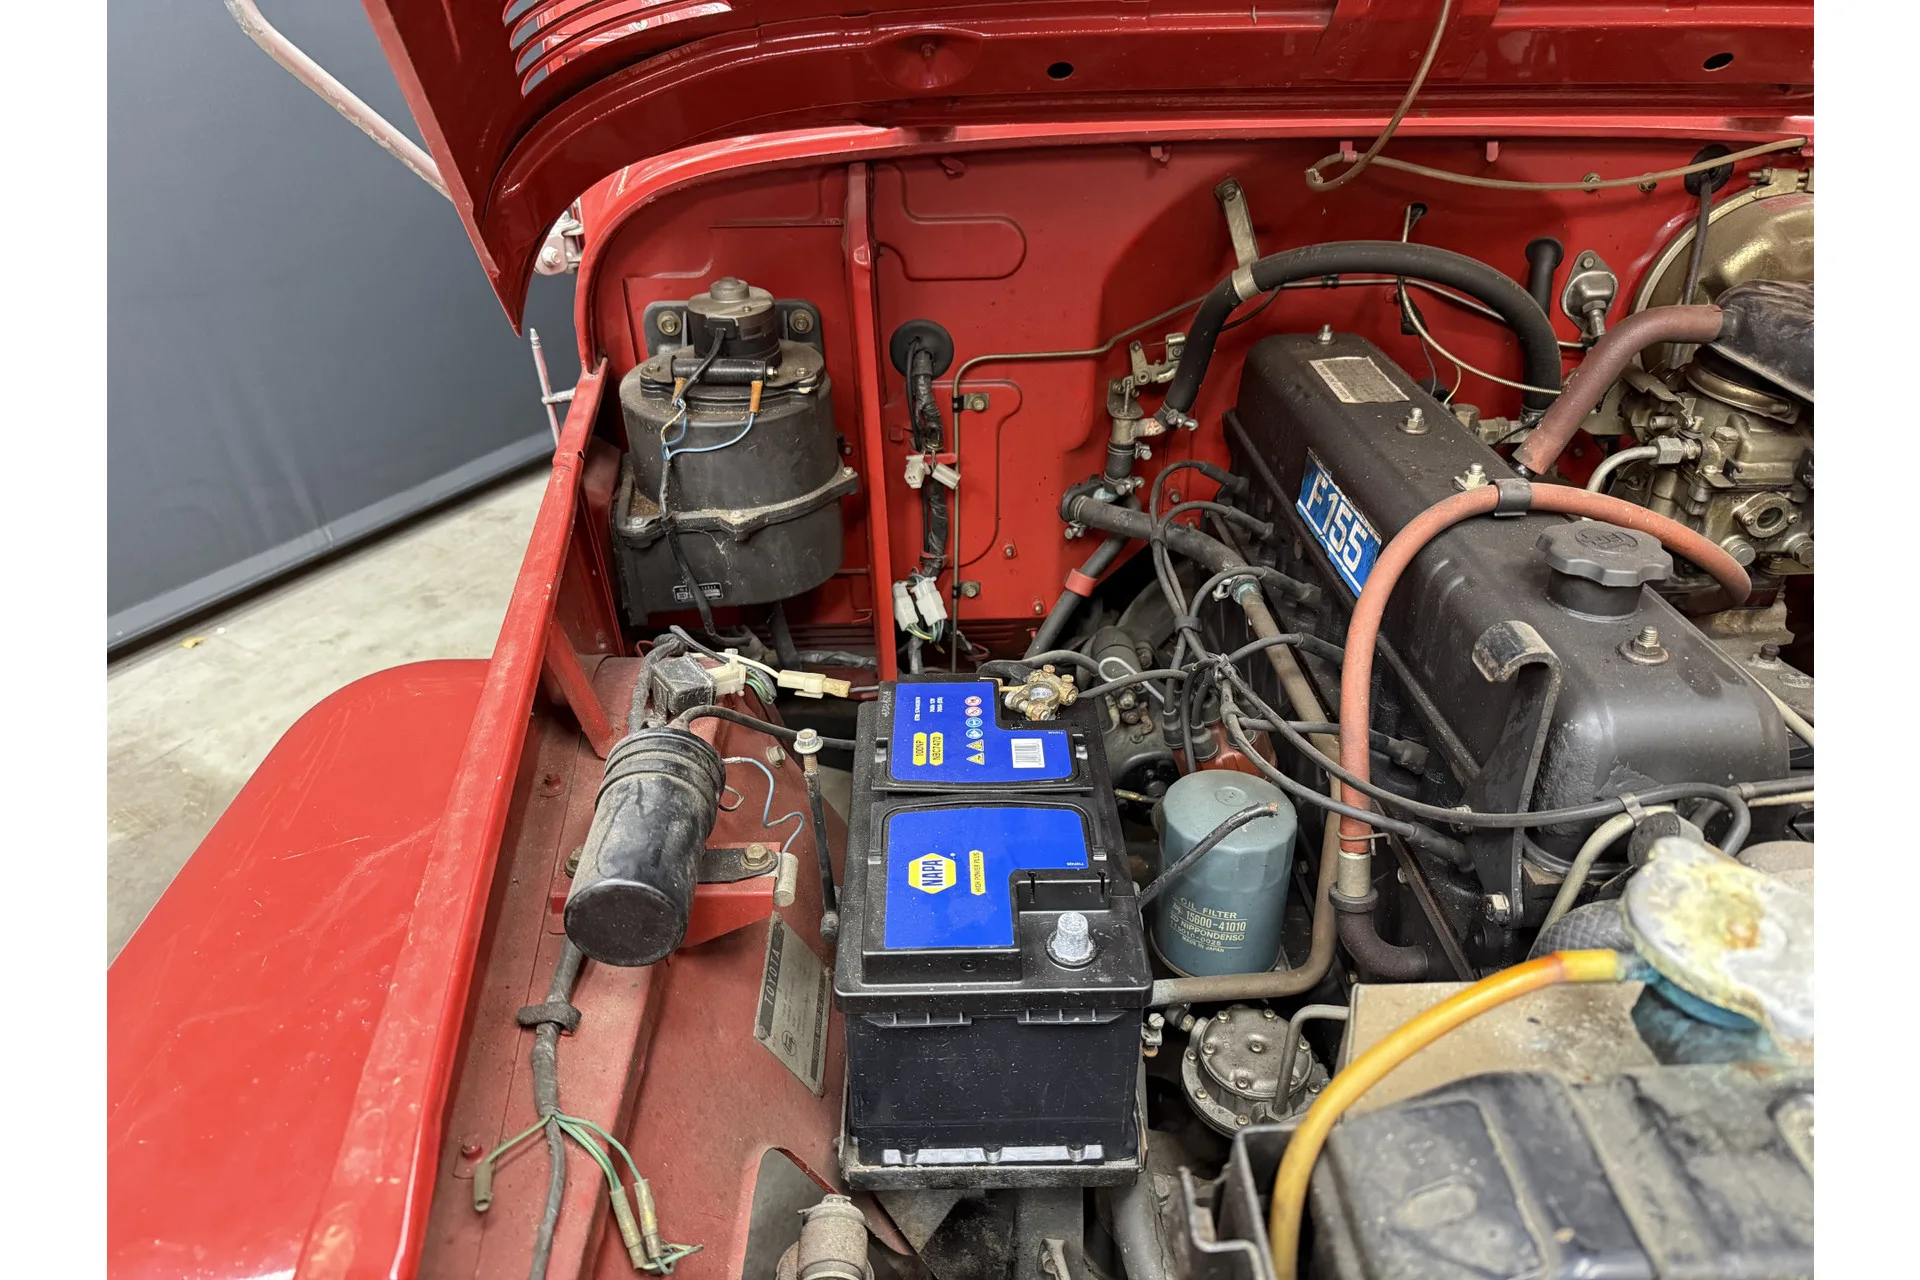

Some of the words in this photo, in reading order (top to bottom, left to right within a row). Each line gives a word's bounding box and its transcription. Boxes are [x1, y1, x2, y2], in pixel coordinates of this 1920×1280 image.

[1306, 472, 1368, 573] F155
[915, 740, 924, 757] 100NP
[932, 736, 942, 761] NBC7470
[921, 859, 944, 887] NAPA
[1181, 897, 1197, 911] OIL
[1202, 907, 1238, 919] FILTER
[1180, 920, 1245, 941] NIPPONDENSO
[1186, 910, 1247, 932] 15600-41010
[1182, 936, 1197, 946] MADE
[764, 950, 781, 1007] TOYOTA
